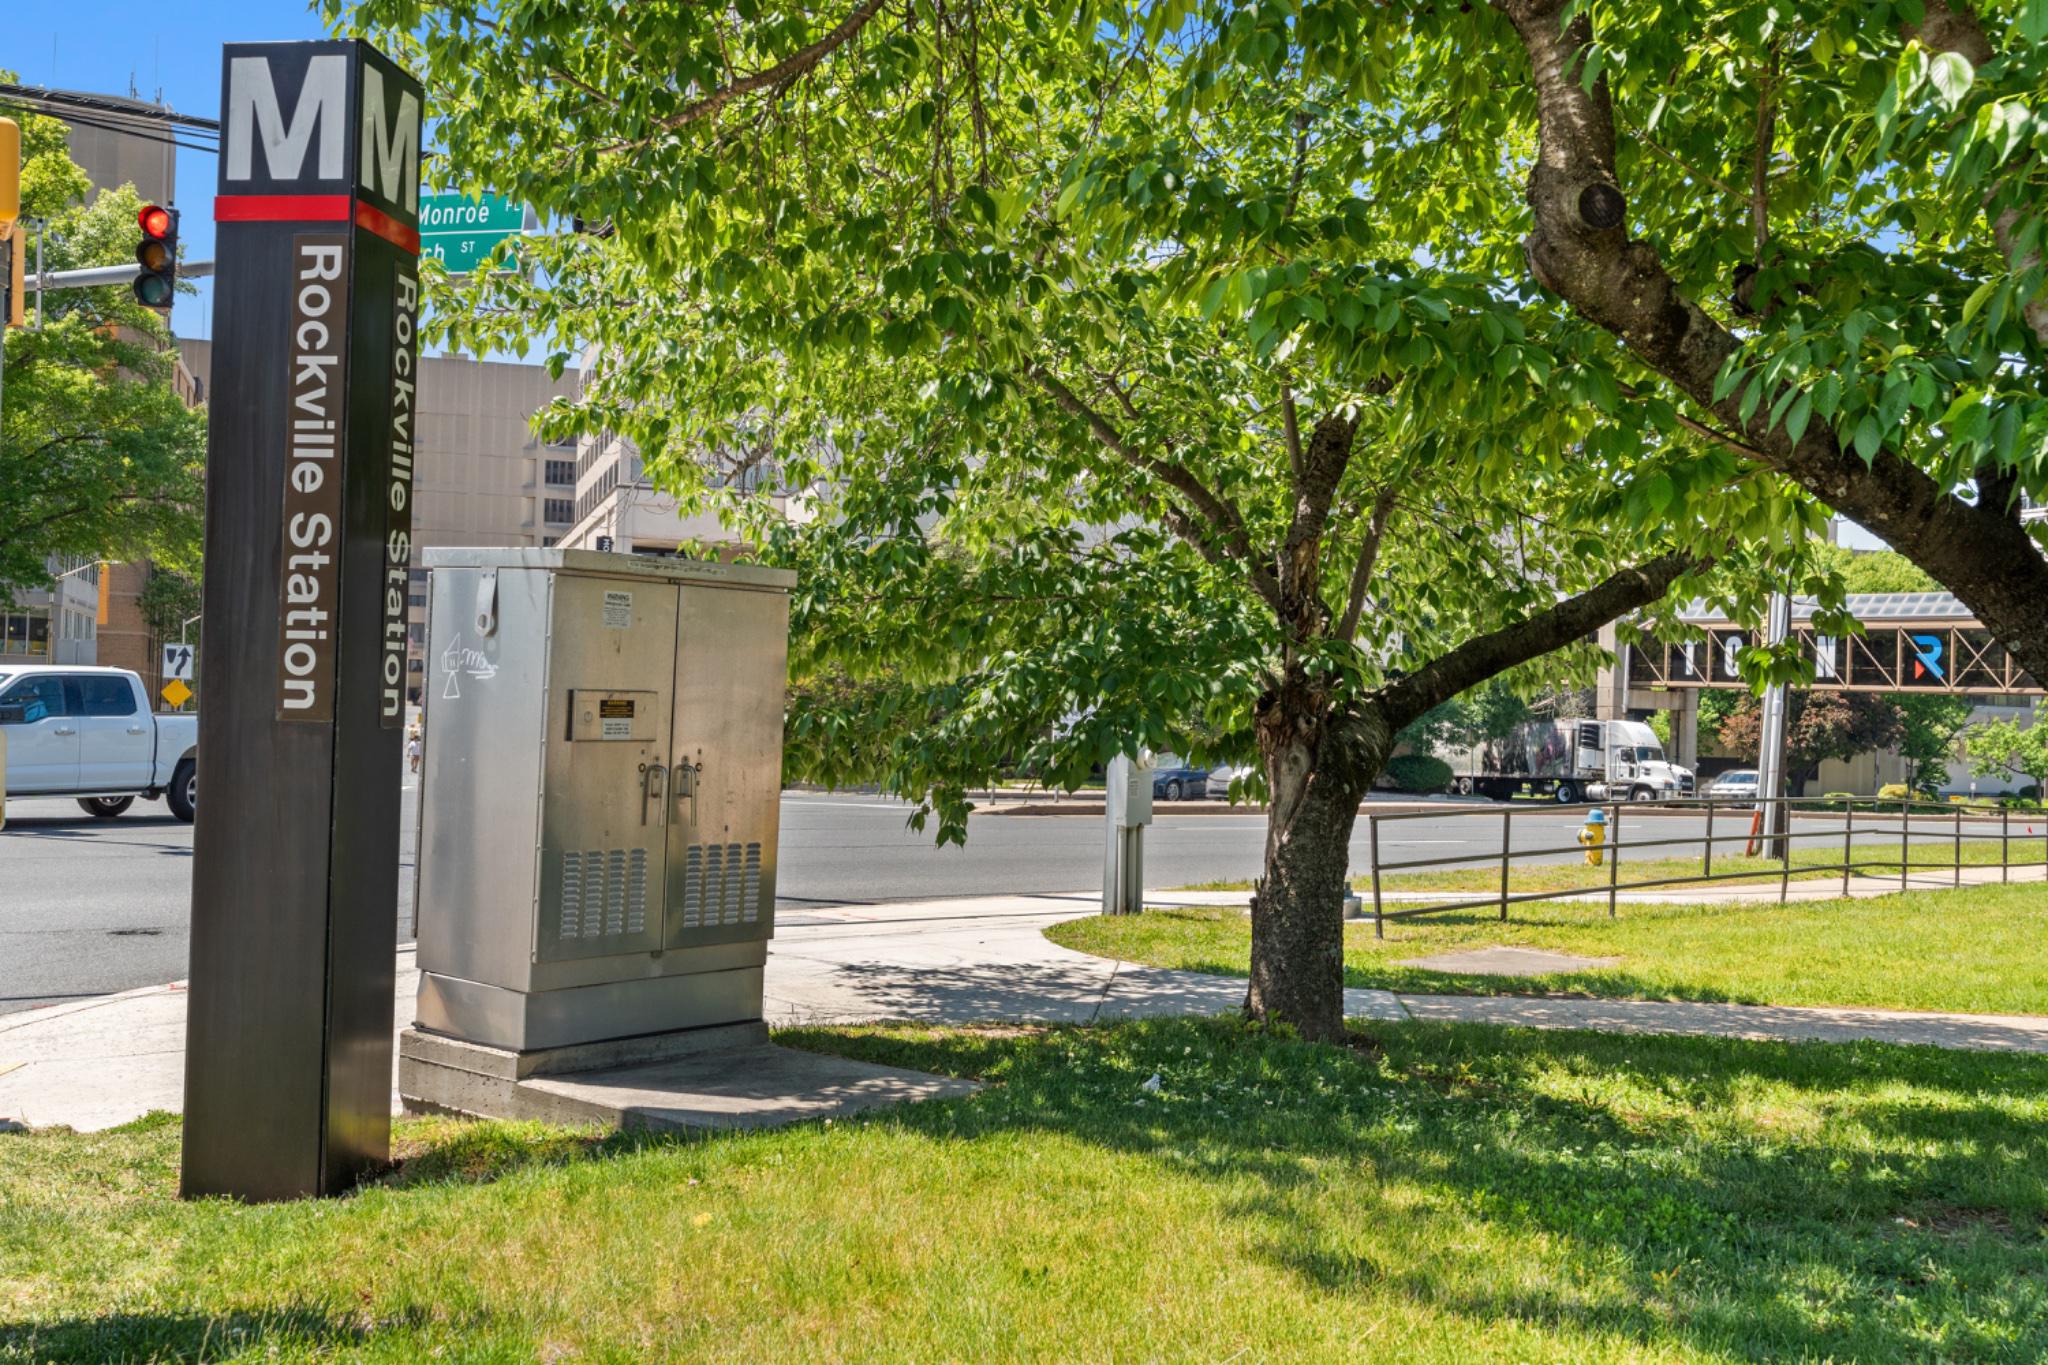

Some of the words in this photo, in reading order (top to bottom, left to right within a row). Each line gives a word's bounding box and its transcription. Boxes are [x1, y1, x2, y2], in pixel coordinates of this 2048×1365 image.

[226, 55, 347, 181] M
[361, 62, 419, 216] M
[419, 204, 489, 226] Monroe
[460, 240, 476, 254] ST
[291, 245, 343, 494] Rockville
[391, 273, 418, 512] Rockville
[283, 512, 333, 710] Station
[384, 528, 410, 717] Station
[1684, 636, 1836, 678] TON
